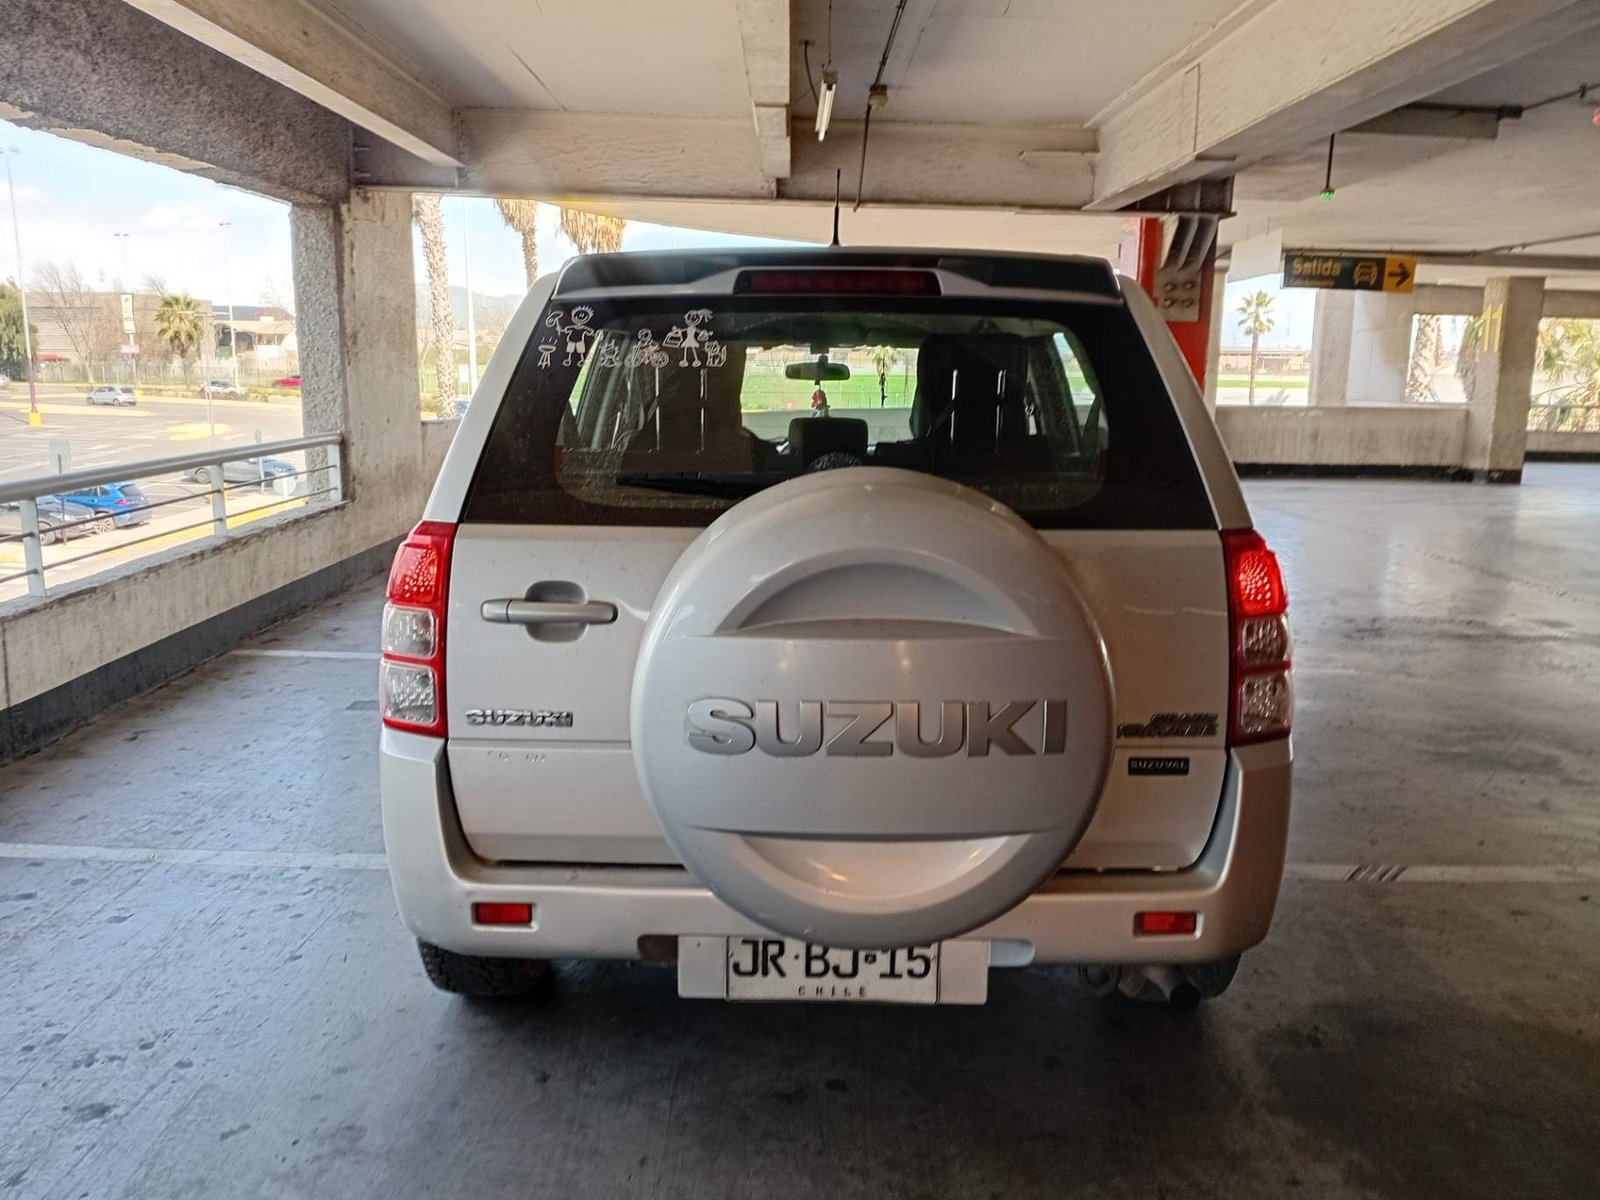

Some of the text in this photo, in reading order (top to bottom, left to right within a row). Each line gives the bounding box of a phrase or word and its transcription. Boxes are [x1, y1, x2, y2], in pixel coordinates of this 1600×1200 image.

[1292, 257, 1341, 276] Salida
[466, 708, 573, 728] SUZUKI
[685, 697, 1067, 757] SUZUKI
[797, 985, 868, 999] CHILE
